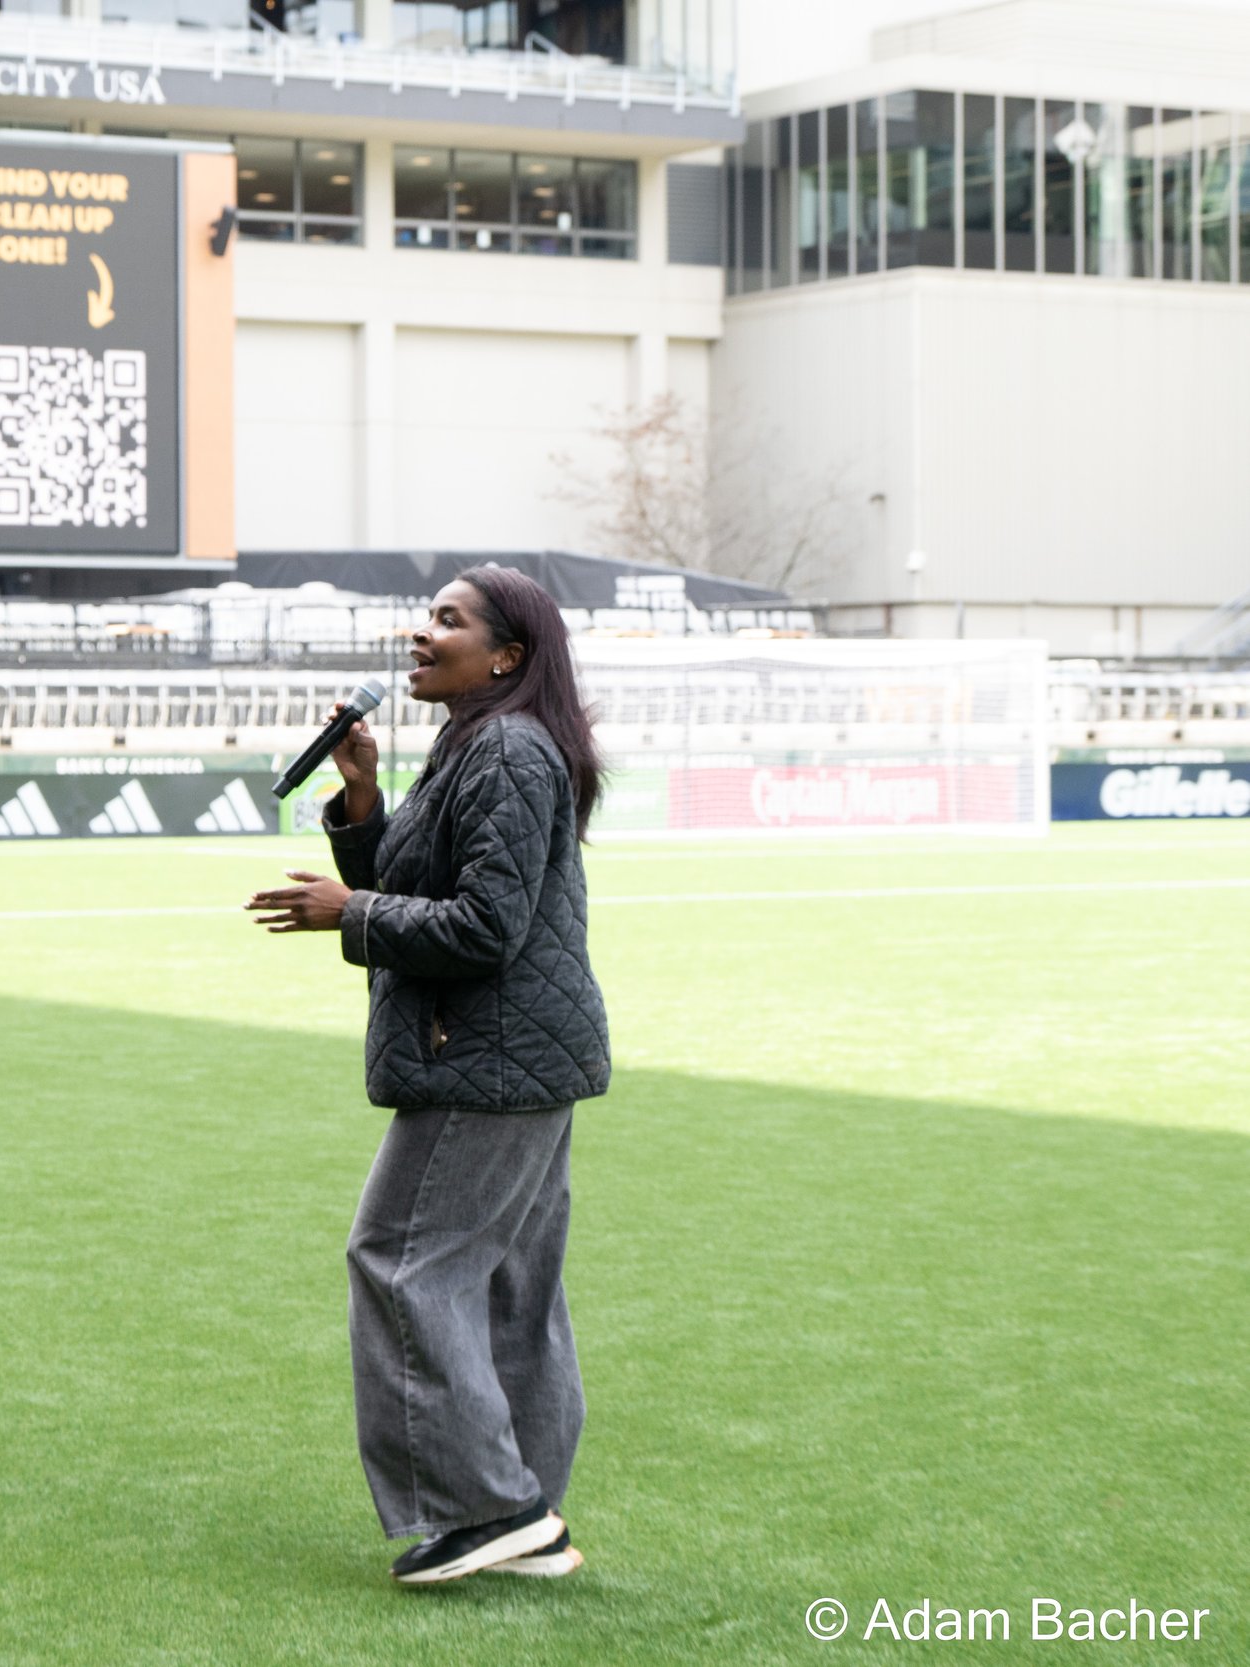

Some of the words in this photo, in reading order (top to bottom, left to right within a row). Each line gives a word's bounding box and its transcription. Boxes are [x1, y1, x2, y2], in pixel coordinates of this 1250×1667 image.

[93, 69, 166, 105] USA
[49, 170, 129, 202] YOUR
[74, 206, 114, 234] UP
[56, 757, 103, 775] BANK
[129, 757, 204, 774] AMERICA
[1102, 767, 1250, 816] Gillette
